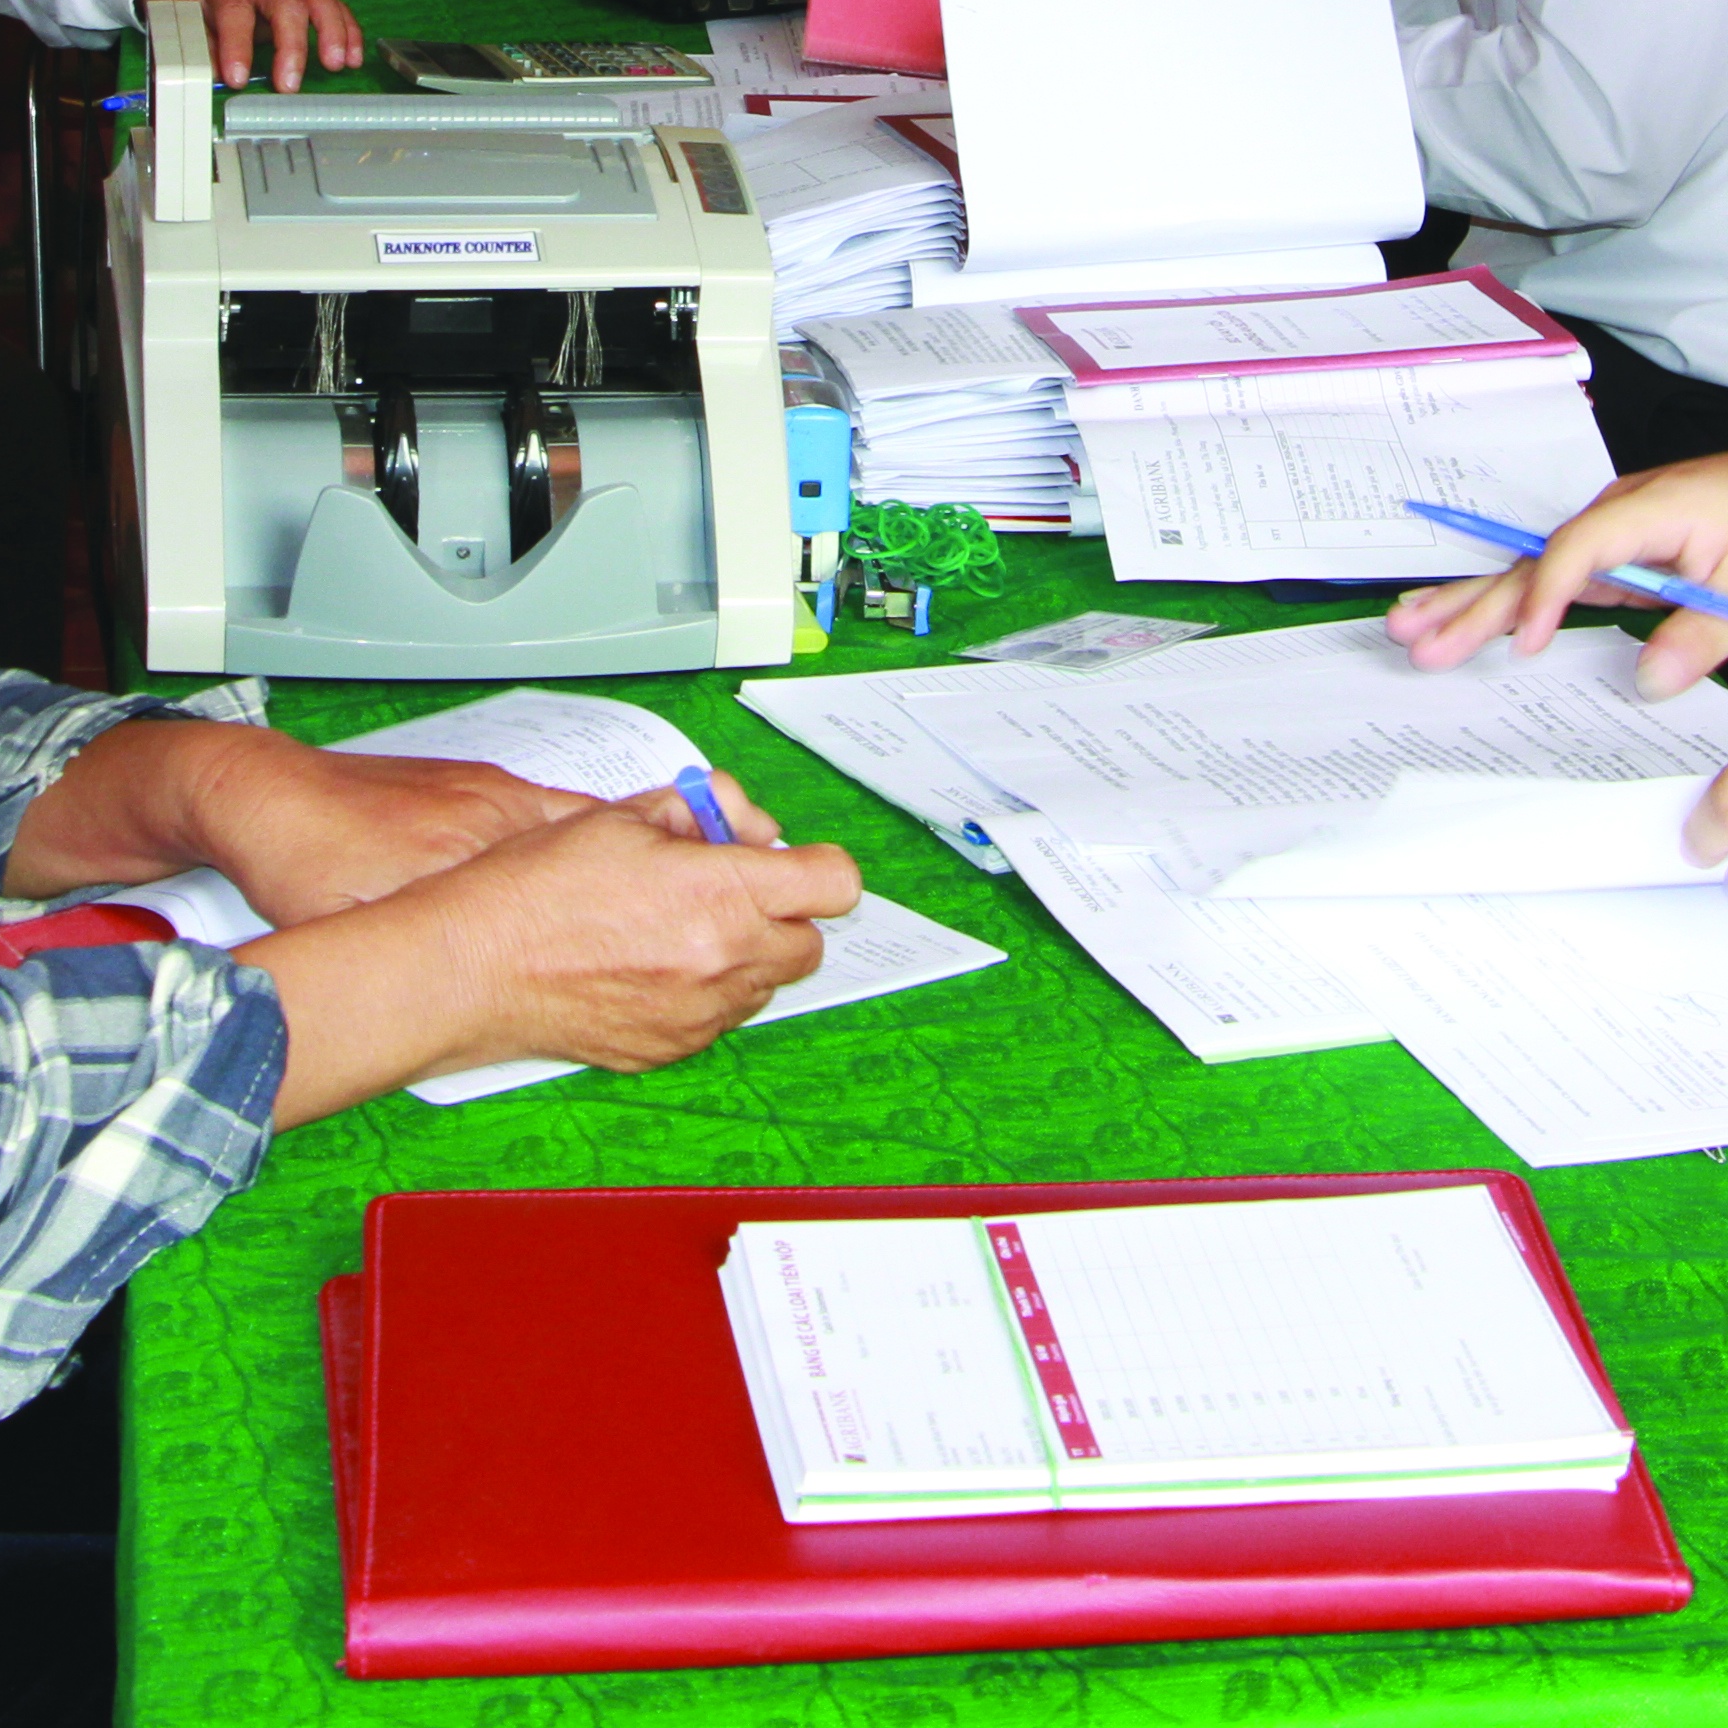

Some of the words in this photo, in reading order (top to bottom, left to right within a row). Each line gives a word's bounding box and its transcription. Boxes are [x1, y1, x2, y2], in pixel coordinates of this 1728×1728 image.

[383, 242, 461, 254] BANKNOTE
[464, 241, 532, 254] COUNTER
[1133, 385, 1145, 411] DANH
[1151, 460, 1172, 522] AGRIBANK
[774, 1240, 799, 1262] NỘP
[781, 1264, 801, 1286] TIỀN
[787, 1288, 813, 1311] LOẠI
[793, 1312, 814, 1333] CÁC
[802, 1350, 827, 1377] BẢNG
[828, 1390, 863, 1453] AGRIBANK
